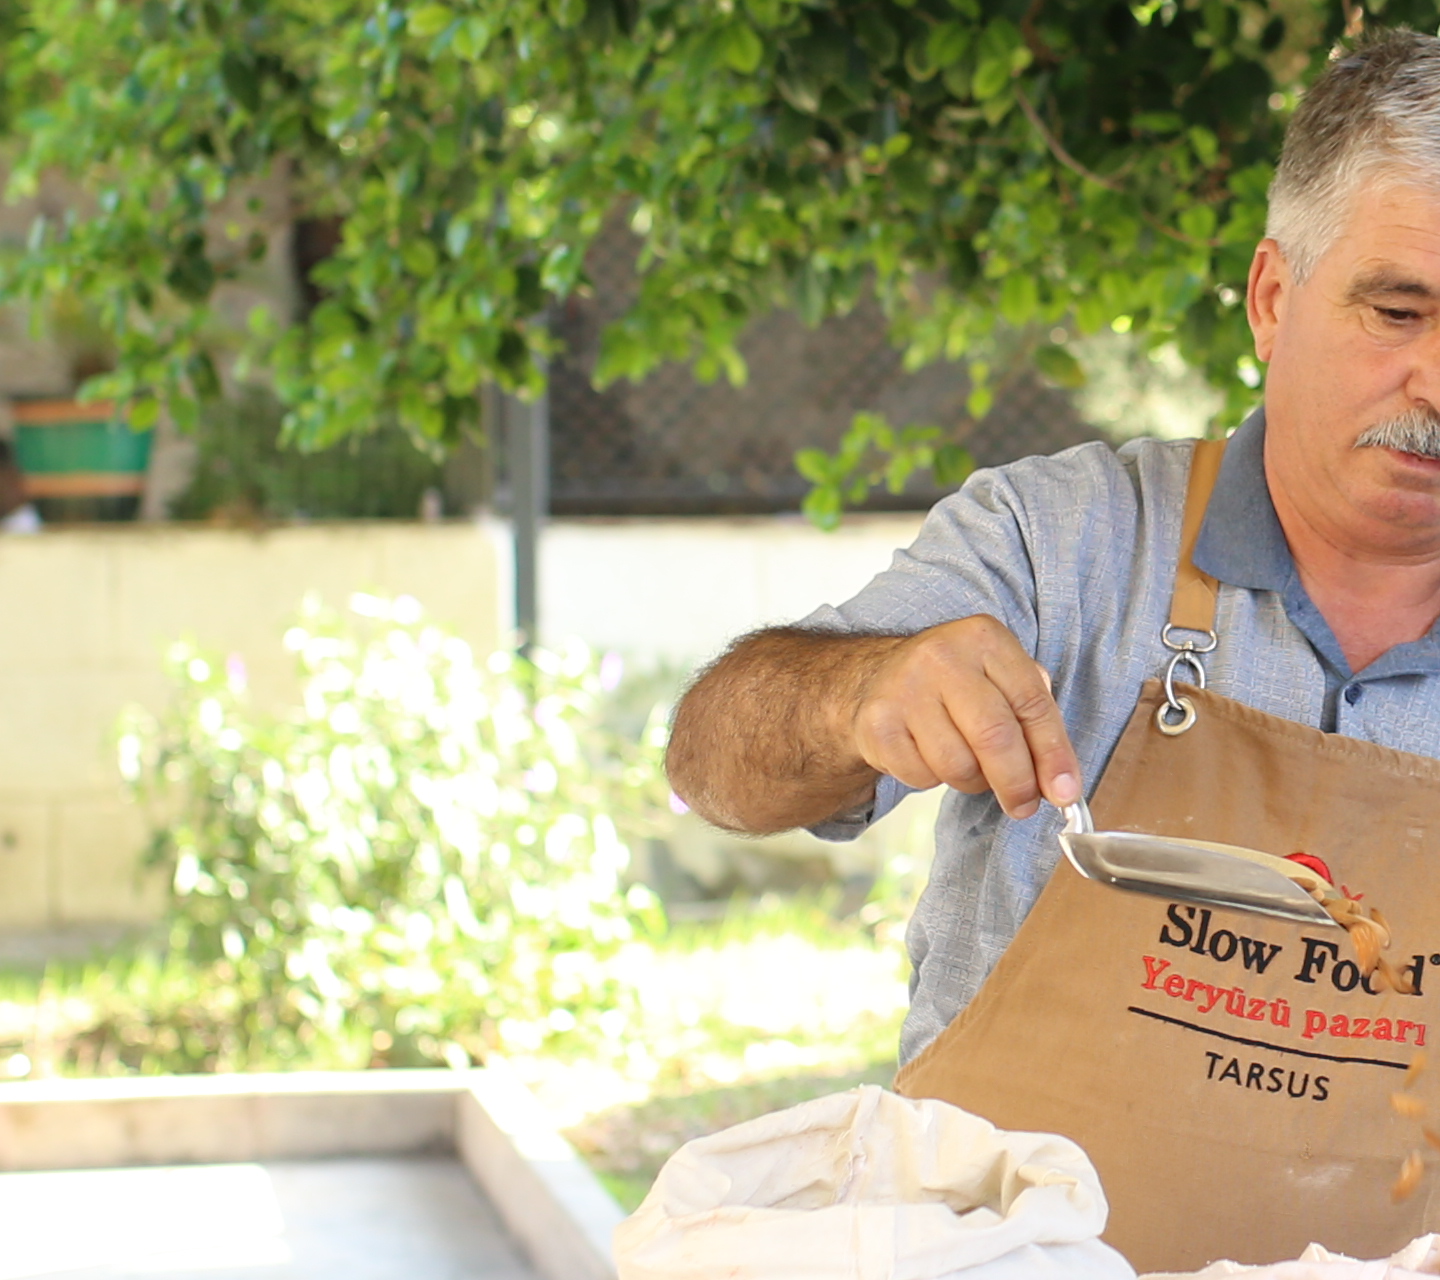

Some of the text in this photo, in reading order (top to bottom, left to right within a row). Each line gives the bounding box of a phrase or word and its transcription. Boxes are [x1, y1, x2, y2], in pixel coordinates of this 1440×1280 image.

[1159, 903, 1283, 975] Slow
[1141, 955, 1427, 1047] Yeryüzü pazarı
[1205, 1051, 1330, 1101] TARSUS
